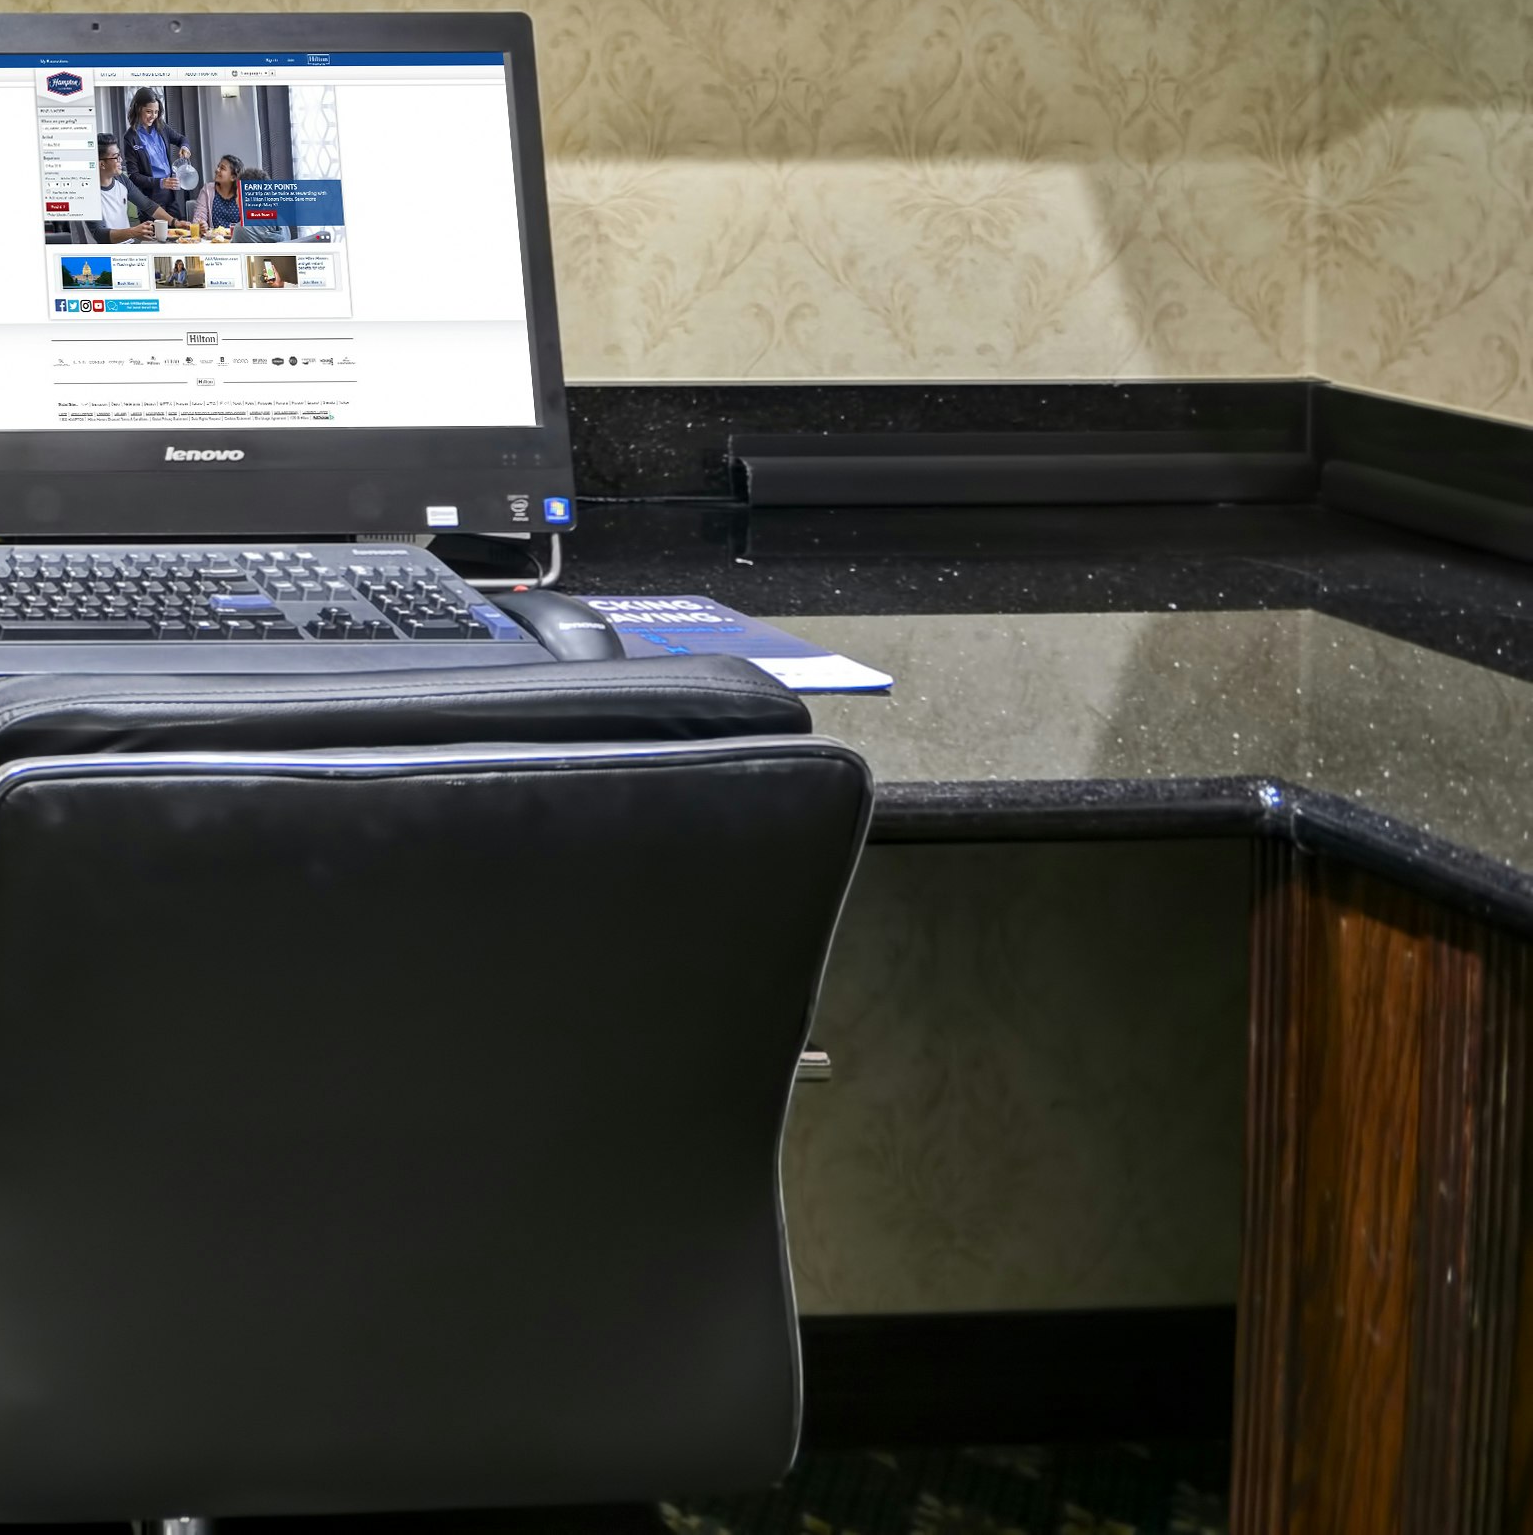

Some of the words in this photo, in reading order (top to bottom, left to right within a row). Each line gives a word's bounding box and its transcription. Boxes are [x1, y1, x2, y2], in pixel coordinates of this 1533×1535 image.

[49, 78, 82, 88] Hampton
[189, 334, 216, 343] Hilton
[164, 446, 245, 461] lenovo
[588, 600, 716, 611] CKING.
[606, 612, 735, 624] AVING.
